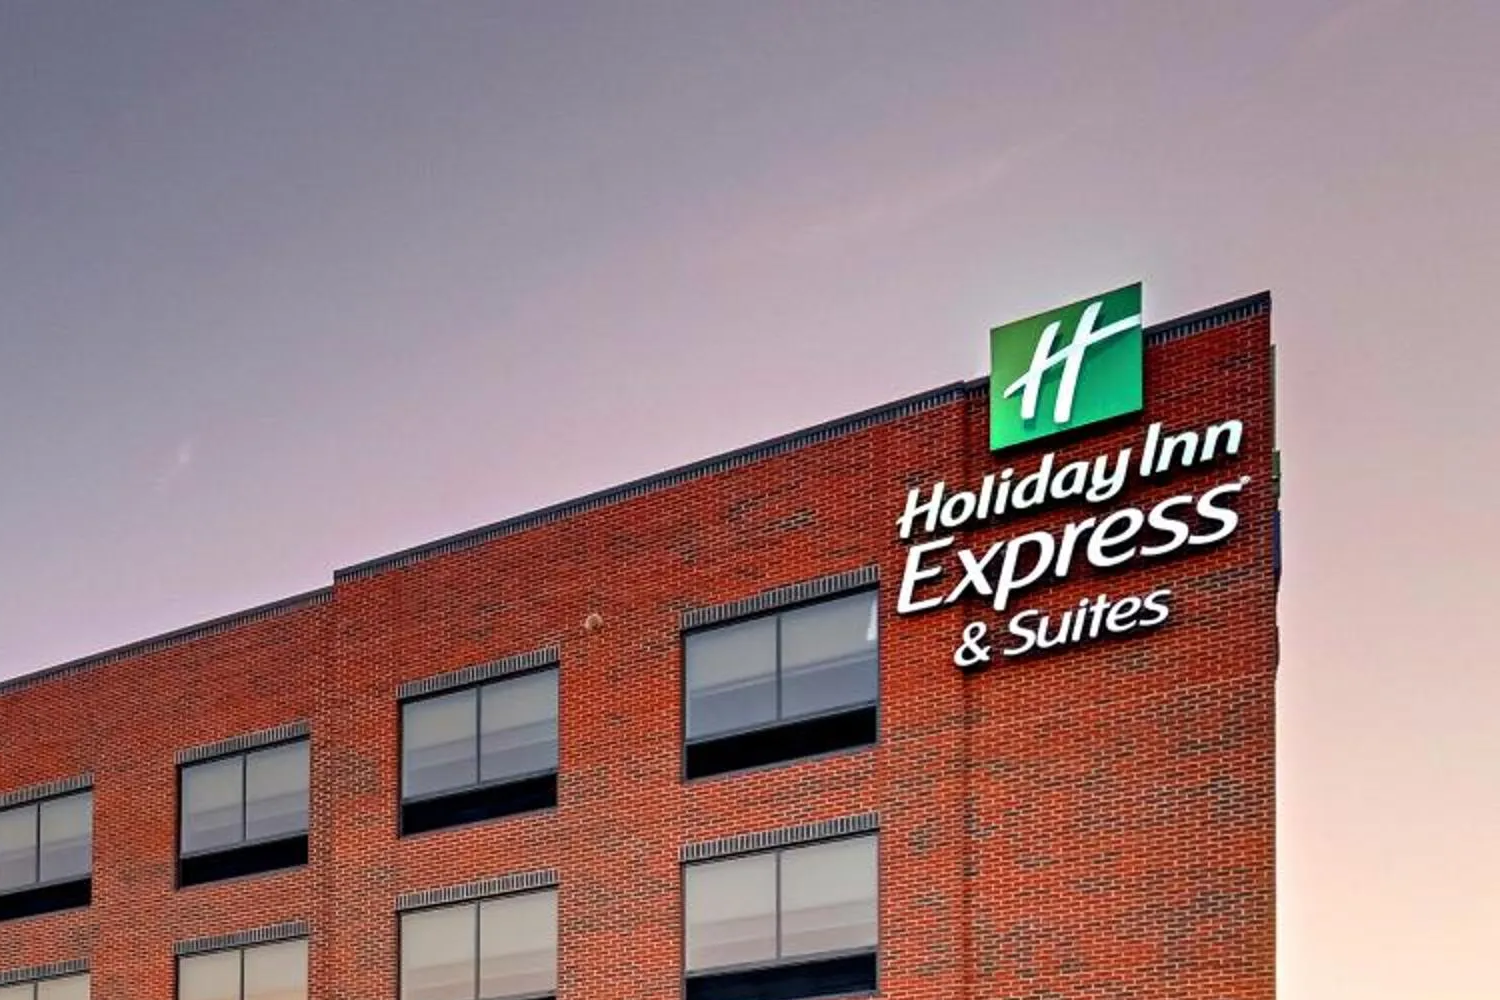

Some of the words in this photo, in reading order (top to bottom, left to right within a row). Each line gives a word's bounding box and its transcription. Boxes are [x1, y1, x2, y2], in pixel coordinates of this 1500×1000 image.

[896, 452, 1132, 539] Holiday
[1140, 420, 1243, 477] Inn
[897, 482, 1242, 613] Express
[953, 621, 991, 666] &
[1003, 589, 1172, 655] Suites
